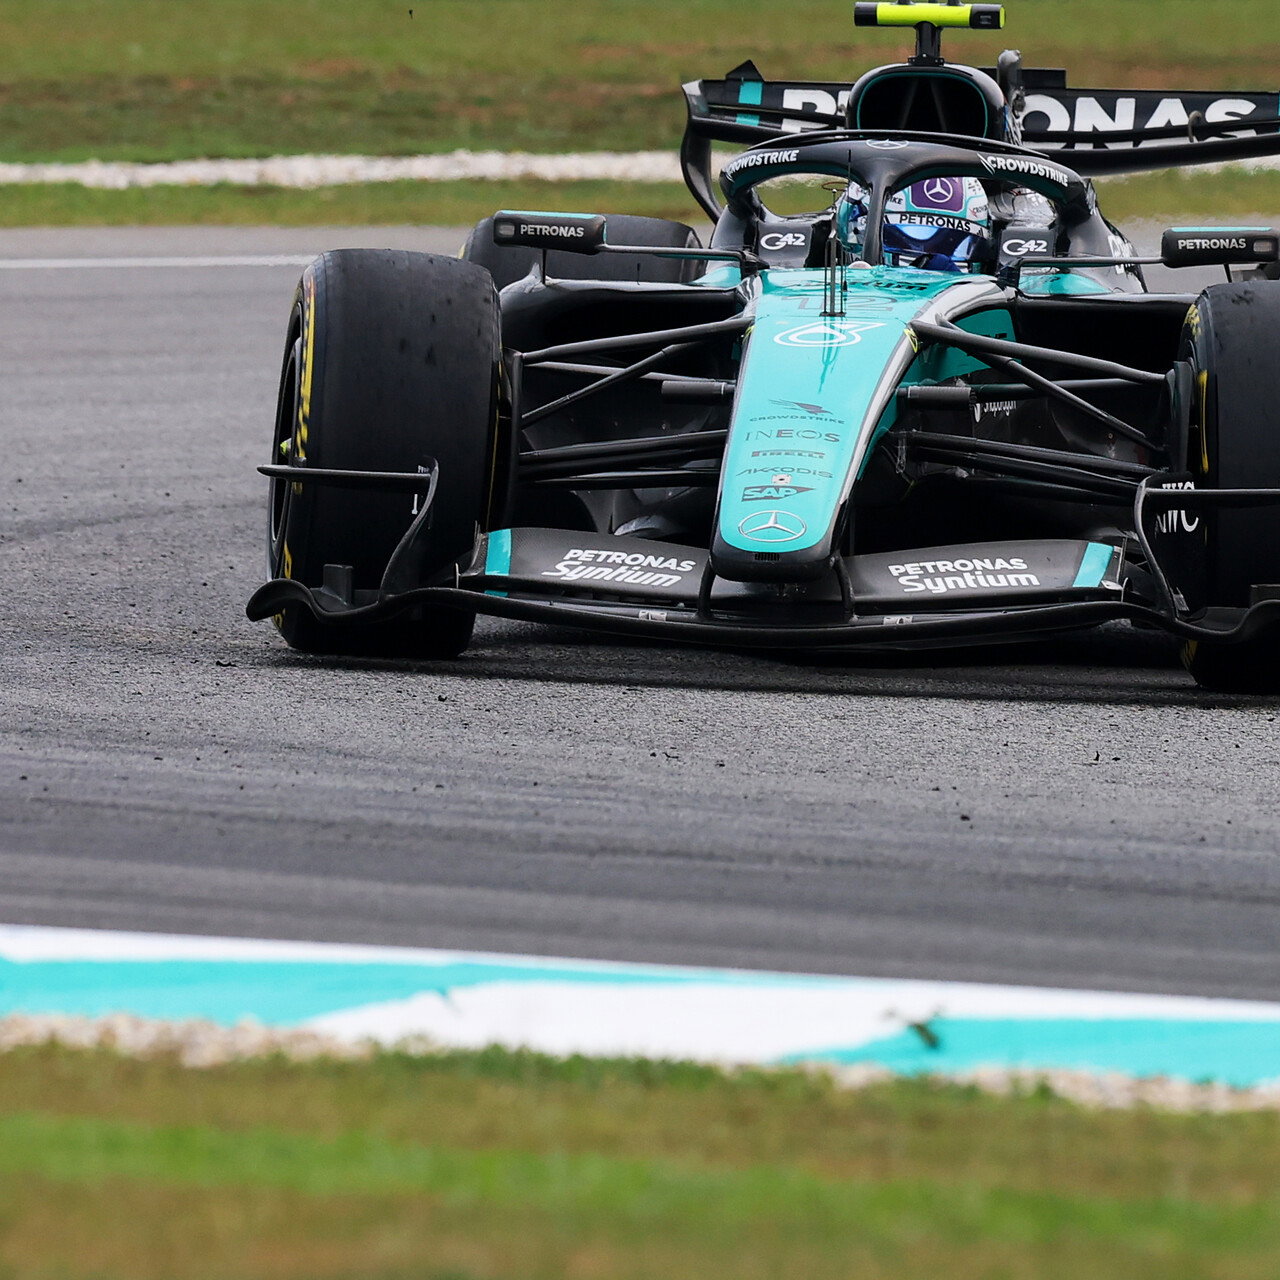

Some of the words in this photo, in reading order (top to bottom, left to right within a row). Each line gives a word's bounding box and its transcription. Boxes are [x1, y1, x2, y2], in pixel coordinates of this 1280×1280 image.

[728, 149, 799, 176] CROWDSTRIKE
[987, 156, 1069, 188] CROWDSTRIKE
[520, 224, 585, 238] PETRONAS
[899, 214, 971, 232] PETRONAS
[760, 232, 806, 251] G42
[1002, 238, 1048, 256] G42
[1178, 238, 1247, 250] PETRONAS
[749, 415, 845, 424] CROWDSTRIKE
[745, 429, 841, 443] INEOS
[736, 466, 834, 478] AKKODIS
[743, 485, 799, 499] SAP
[562, 548, 697, 572] PETRONAS
[888, 557, 1028, 577] PETRONAS
[541, 561, 682, 588] Syntium
[898, 571, 1041, 594] Syntium
